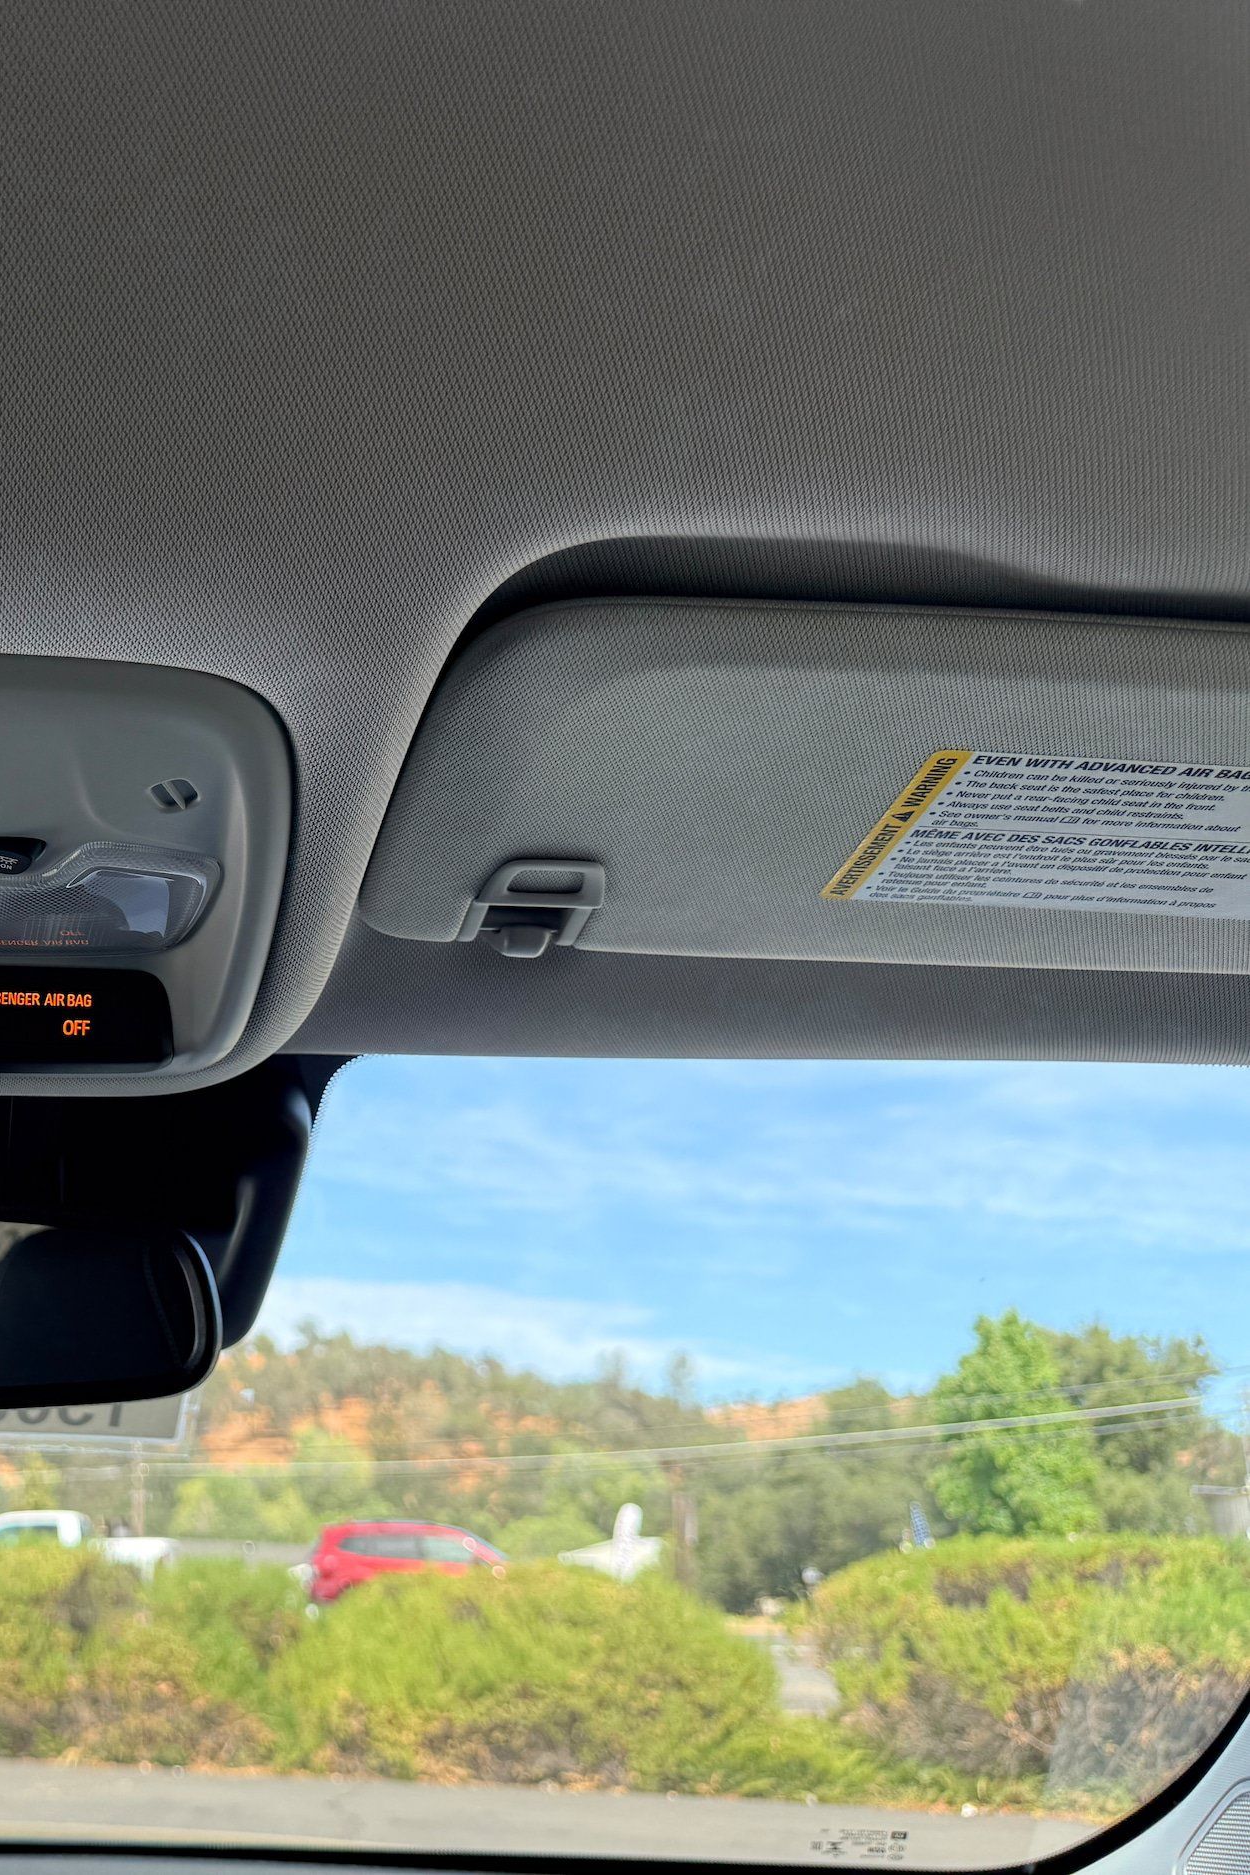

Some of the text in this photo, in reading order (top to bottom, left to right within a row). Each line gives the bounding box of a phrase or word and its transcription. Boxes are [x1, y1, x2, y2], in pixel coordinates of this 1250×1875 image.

[972, 755, 1022, 767] EVEN
[1026, 758, 1074, 769] WITH
[1075, 761, 1176, 775] ADVANCED
[1178, 766, 1214, 777] AIR
[901, 757, 957, 807] WARNING
[974, 771, 1024, 779] Children
[1070, 776, 1104, 784] killed
[1120, 779, 1177, 789] seriously
[1178, 782, 1223, 792] injured
[1224, 784, 1240, 793] by
[991, 793, 1013, 801] put
[1024, 795, 1089, 805] rear-facing
[1120, 790, 1154, 798] place
[1176, 793, 1225, 801] children.
[946, 801, 988, 811] Always
[1127, 811, 1183, 819] restraints.
[950, 821, 978, 829] bags.
[964, 812, 1012, 820] owner's
[1135, 822, 1204, 830] information
[910, 828, 962, 839] MÊME
[962, 832, 1006, 841] AVEC
[1007, 834, 1040, 843] DES
[1042, 836, 1087, 846] SACS
[1089, 838, 1193, 851] GONFLABLES
[830, 823, 902, 895] AVERTISSEMENT
[44, 992, 66, 1008] AIR
[67, 993, 92, 1008] BAG
[62, 1020, 91, 1036] OFF
